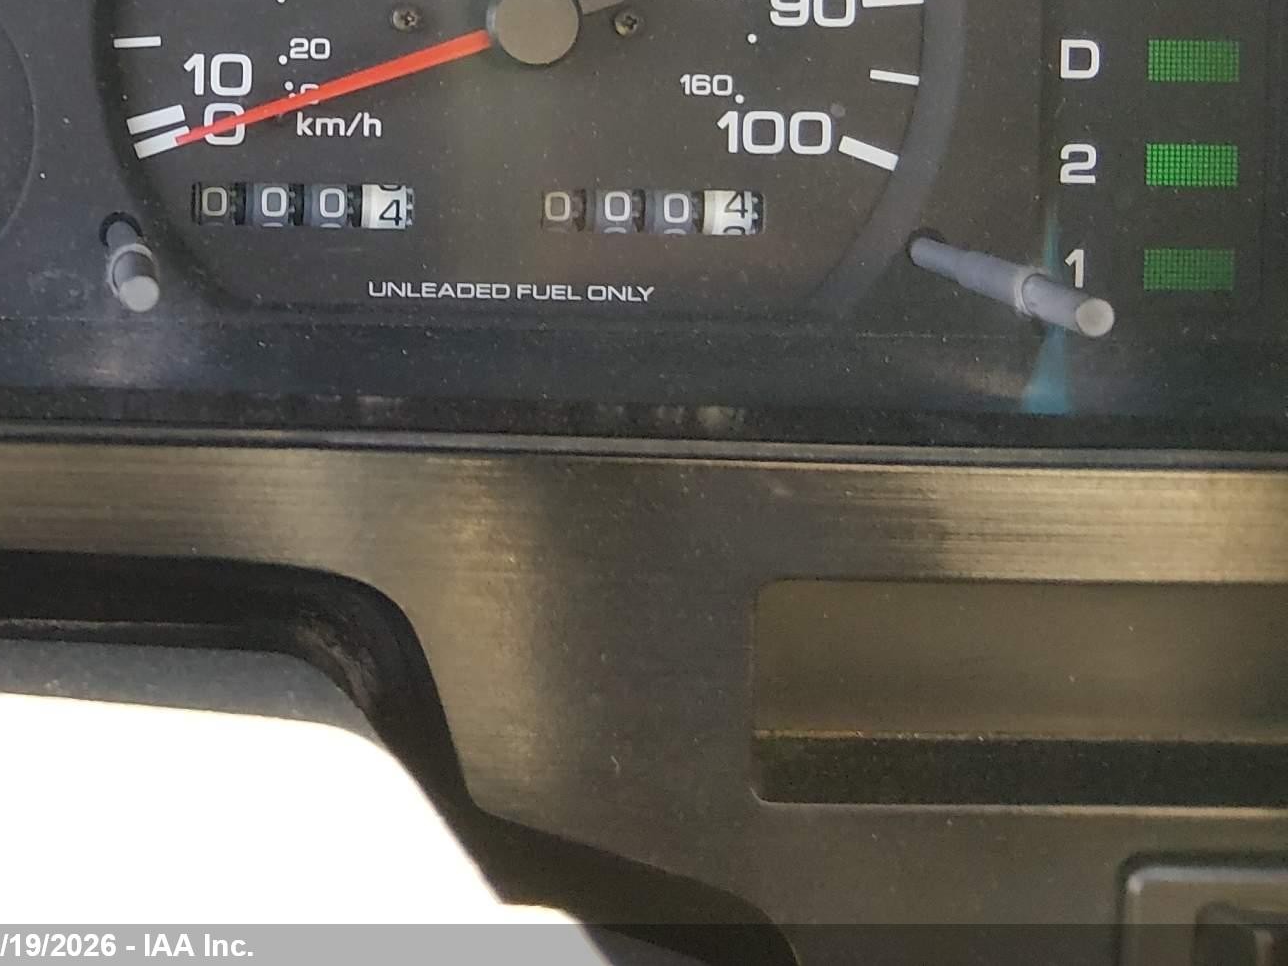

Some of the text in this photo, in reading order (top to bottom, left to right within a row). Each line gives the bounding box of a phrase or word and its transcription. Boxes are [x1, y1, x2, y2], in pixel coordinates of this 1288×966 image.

[289, 37, 331, 60] 20
[1060, 39, 1100, 79] D
[183, 53, 253, 97] 10
[679, 74, 733, 96] 160
[203, 102, 246, 146] 0
[296, 111, 382, 137] km/h
[717, 110, 832, 155] 100
[1059, 143, 1097, 184] 2
[1064, 248, 1085, 288] 1
[368, 281, 655, 302] UNLEADED FUEL ONLY
